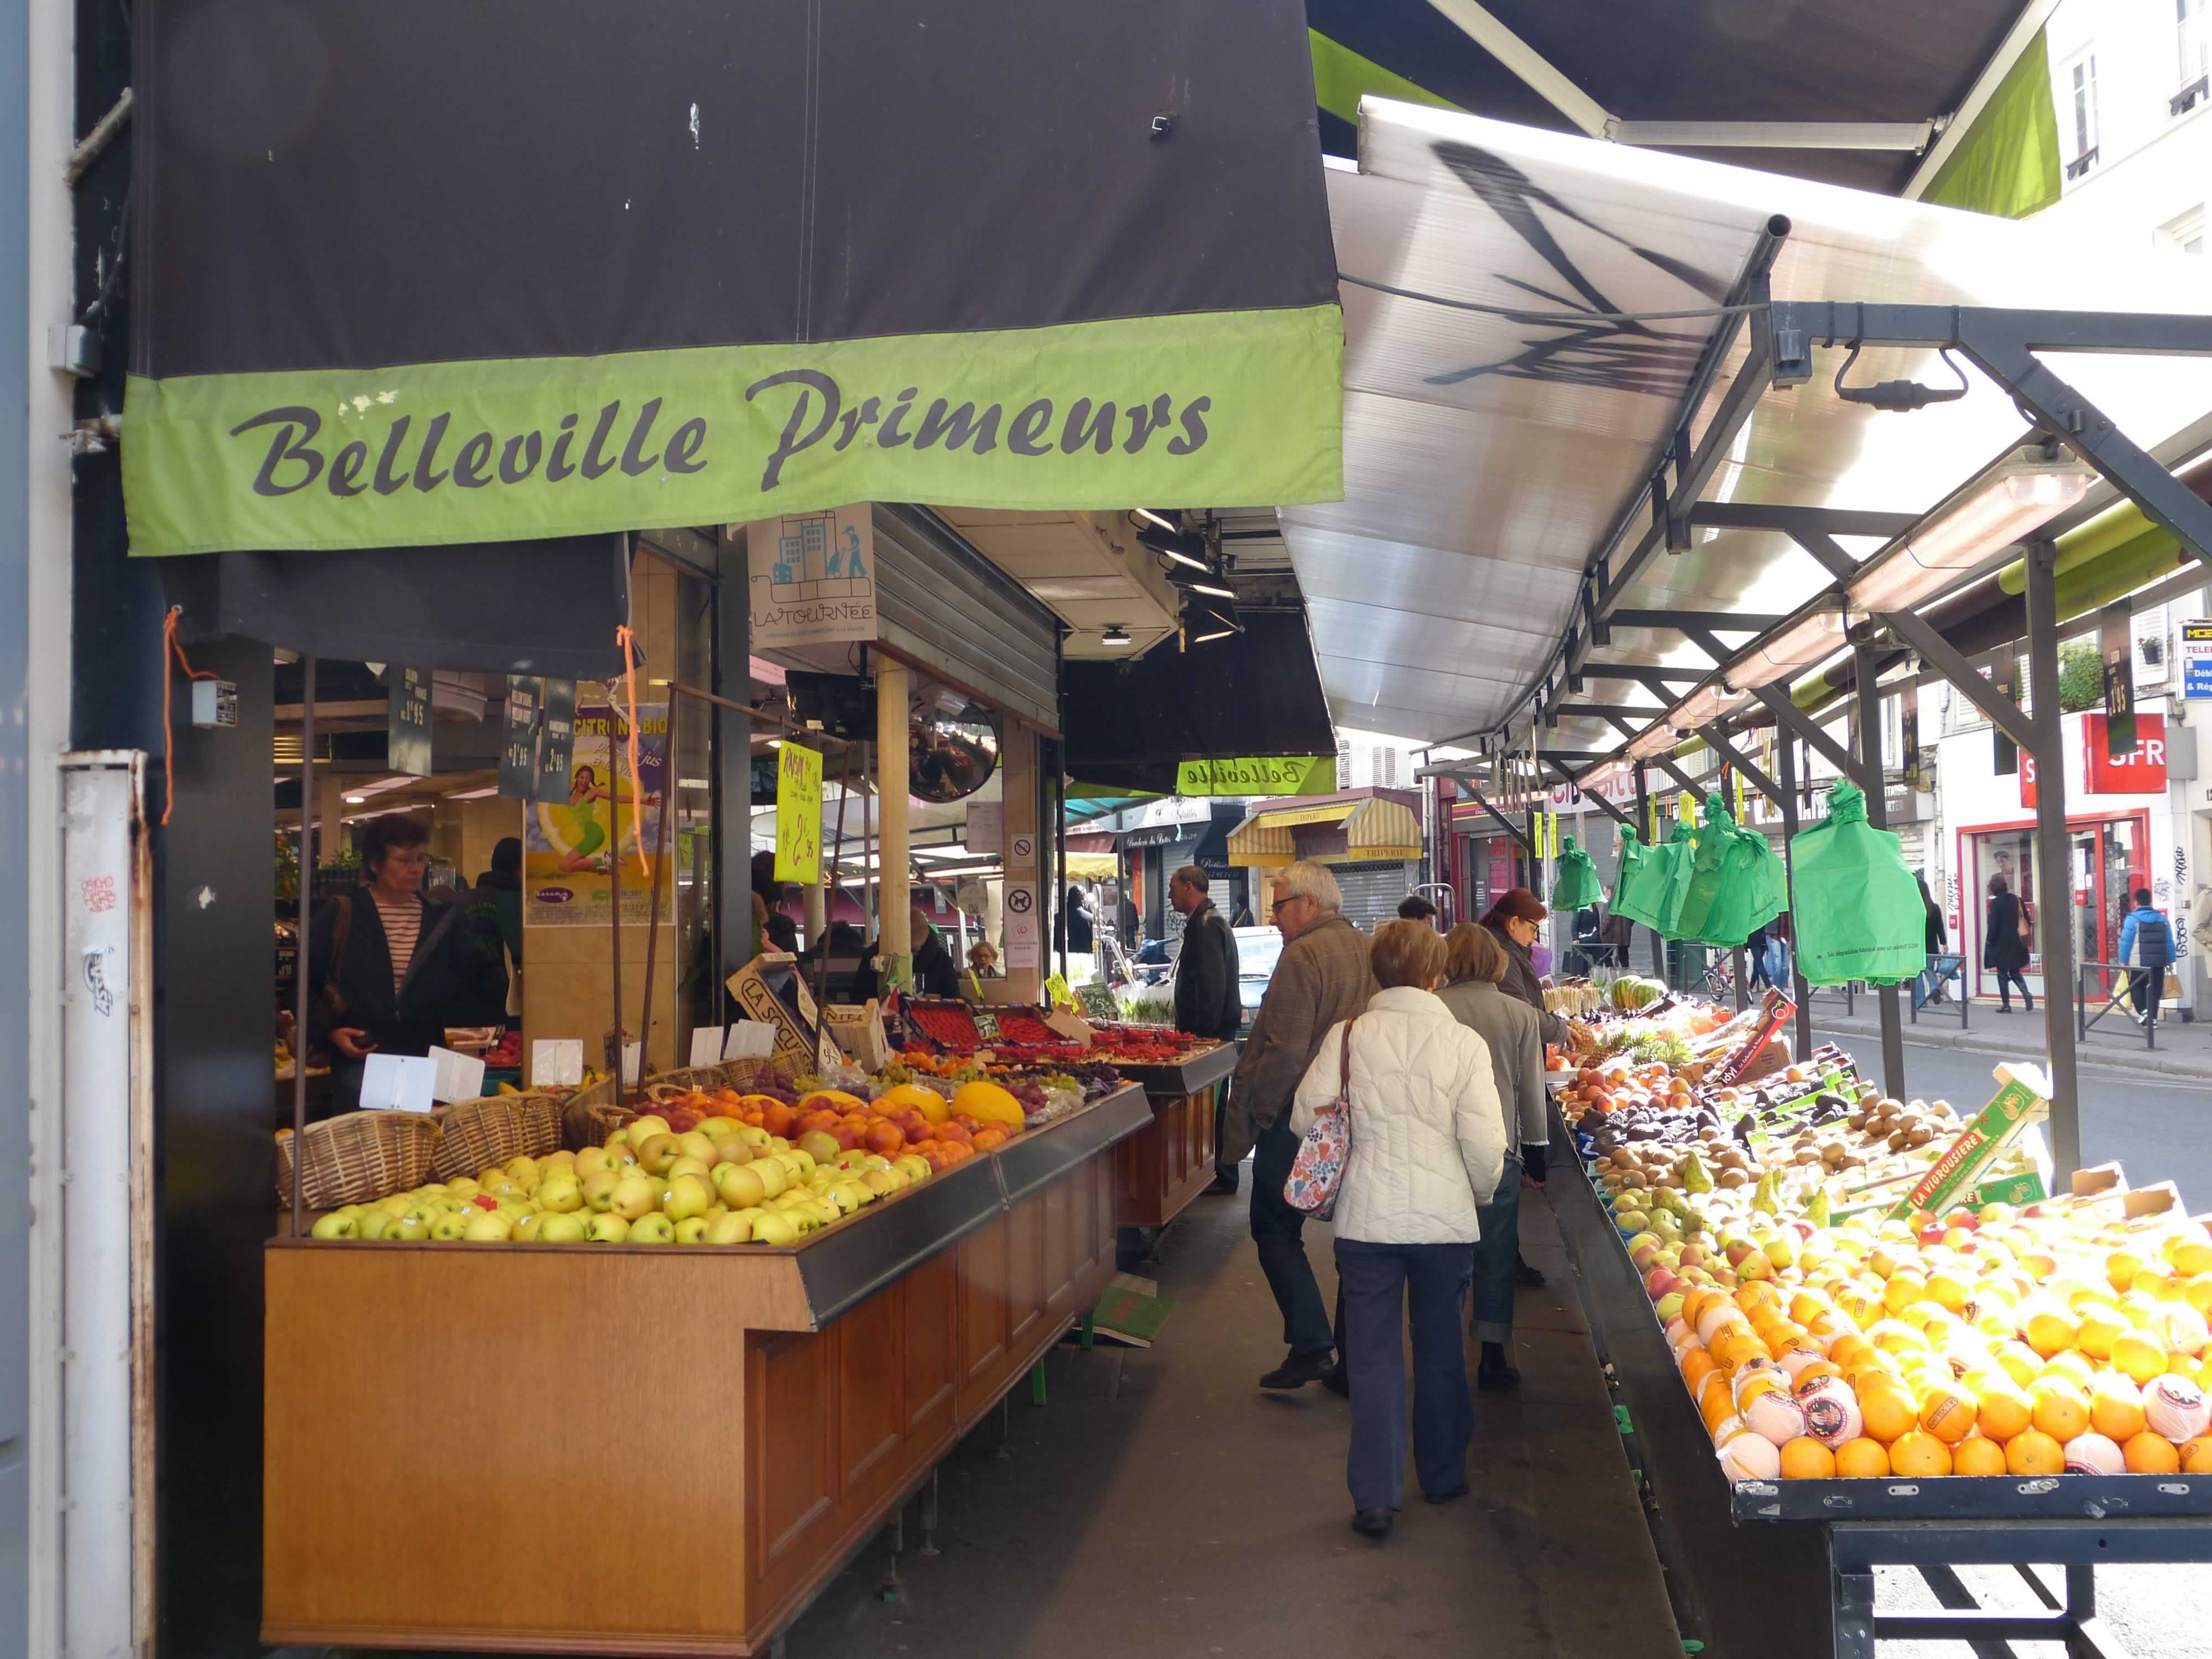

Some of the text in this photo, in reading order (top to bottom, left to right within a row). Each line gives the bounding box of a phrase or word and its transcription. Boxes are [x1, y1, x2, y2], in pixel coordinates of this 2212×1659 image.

[229, 369, 1212, 497] Belleville Primeurs
[573, 718, 636, 737] CITRN
[637, 751, 662, 767] jus
[1366, 849, 1404, 857] TRIPERIE
[744, 982, 764, 1008] LA
[1913, 1192, 1927, 1207] LA
[1923, 1134, 1978, 1194] VIGROUSIERE
